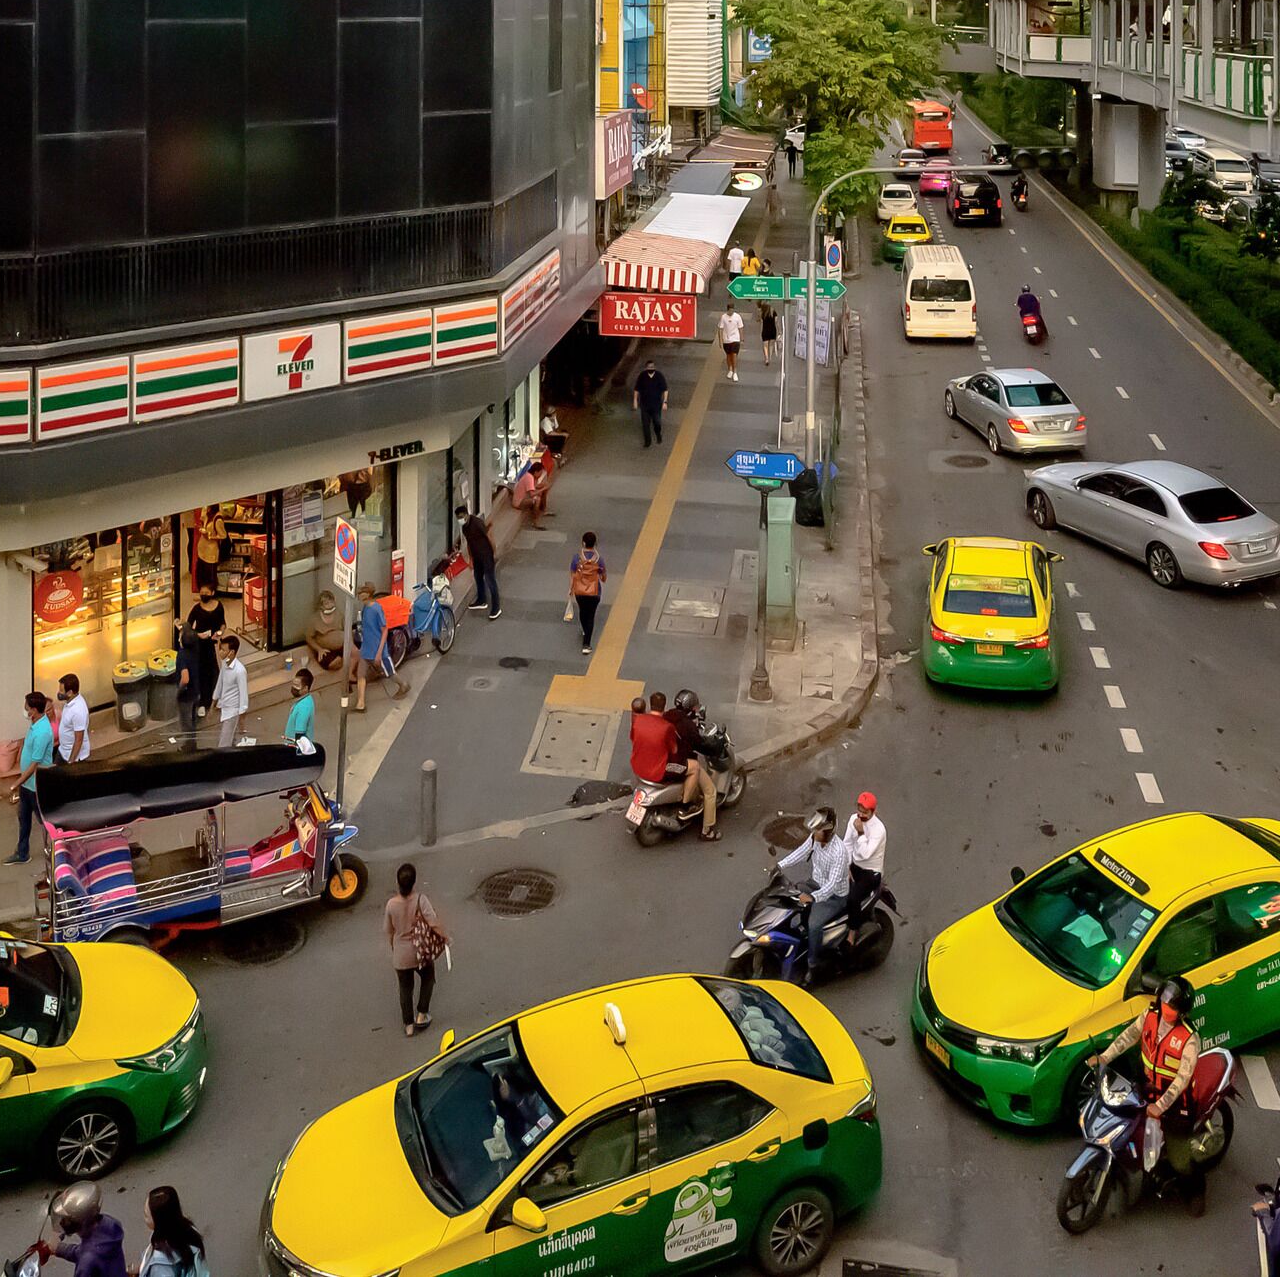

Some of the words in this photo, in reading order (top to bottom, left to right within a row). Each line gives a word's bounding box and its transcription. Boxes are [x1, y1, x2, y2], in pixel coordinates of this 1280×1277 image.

[614, 300, 682, 324] RAJA'S
[614, 324, 646, 332] CUSTOM
[650, 325, 680, 333] TAILOR
[736, 453, 767, 466] สุขุมวิท
[786, 458, 795, 473] 11
[1100, 854, 1136, 887] MeterZing
[1268, 958, 1280, 972] TAXI
